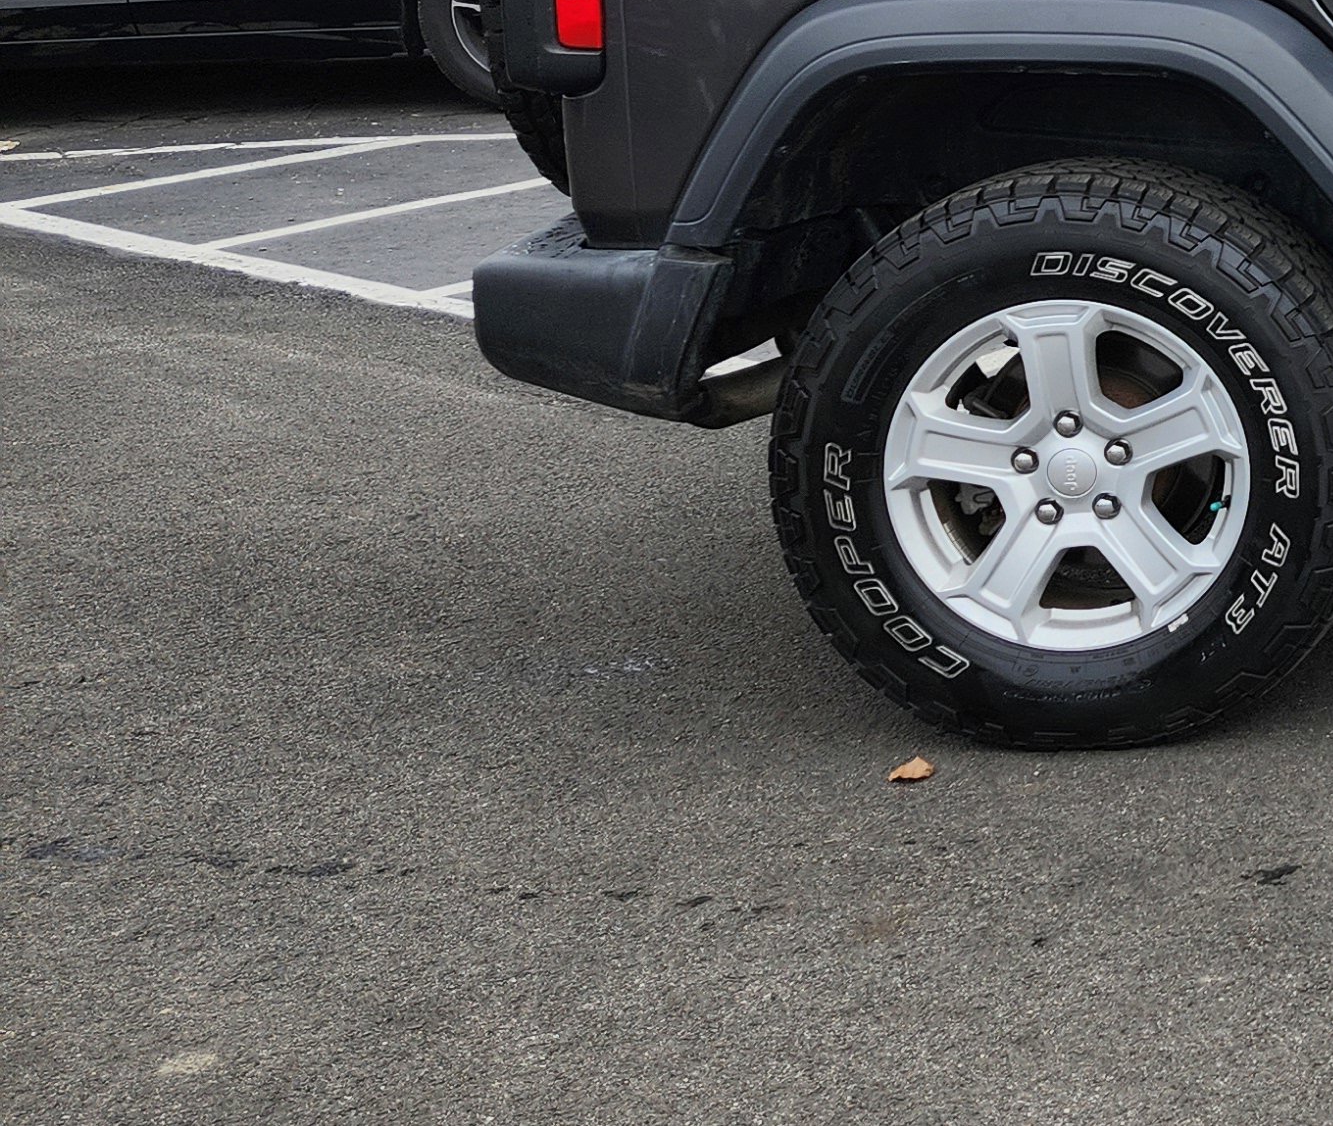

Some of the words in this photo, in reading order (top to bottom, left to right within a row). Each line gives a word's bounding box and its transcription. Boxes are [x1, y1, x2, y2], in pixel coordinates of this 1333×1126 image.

[1029, 249, 1302, 499] DISCOVERER
[822, 442, 972, 678] COOPER
[1224, 523, 1293, 636] AT3
